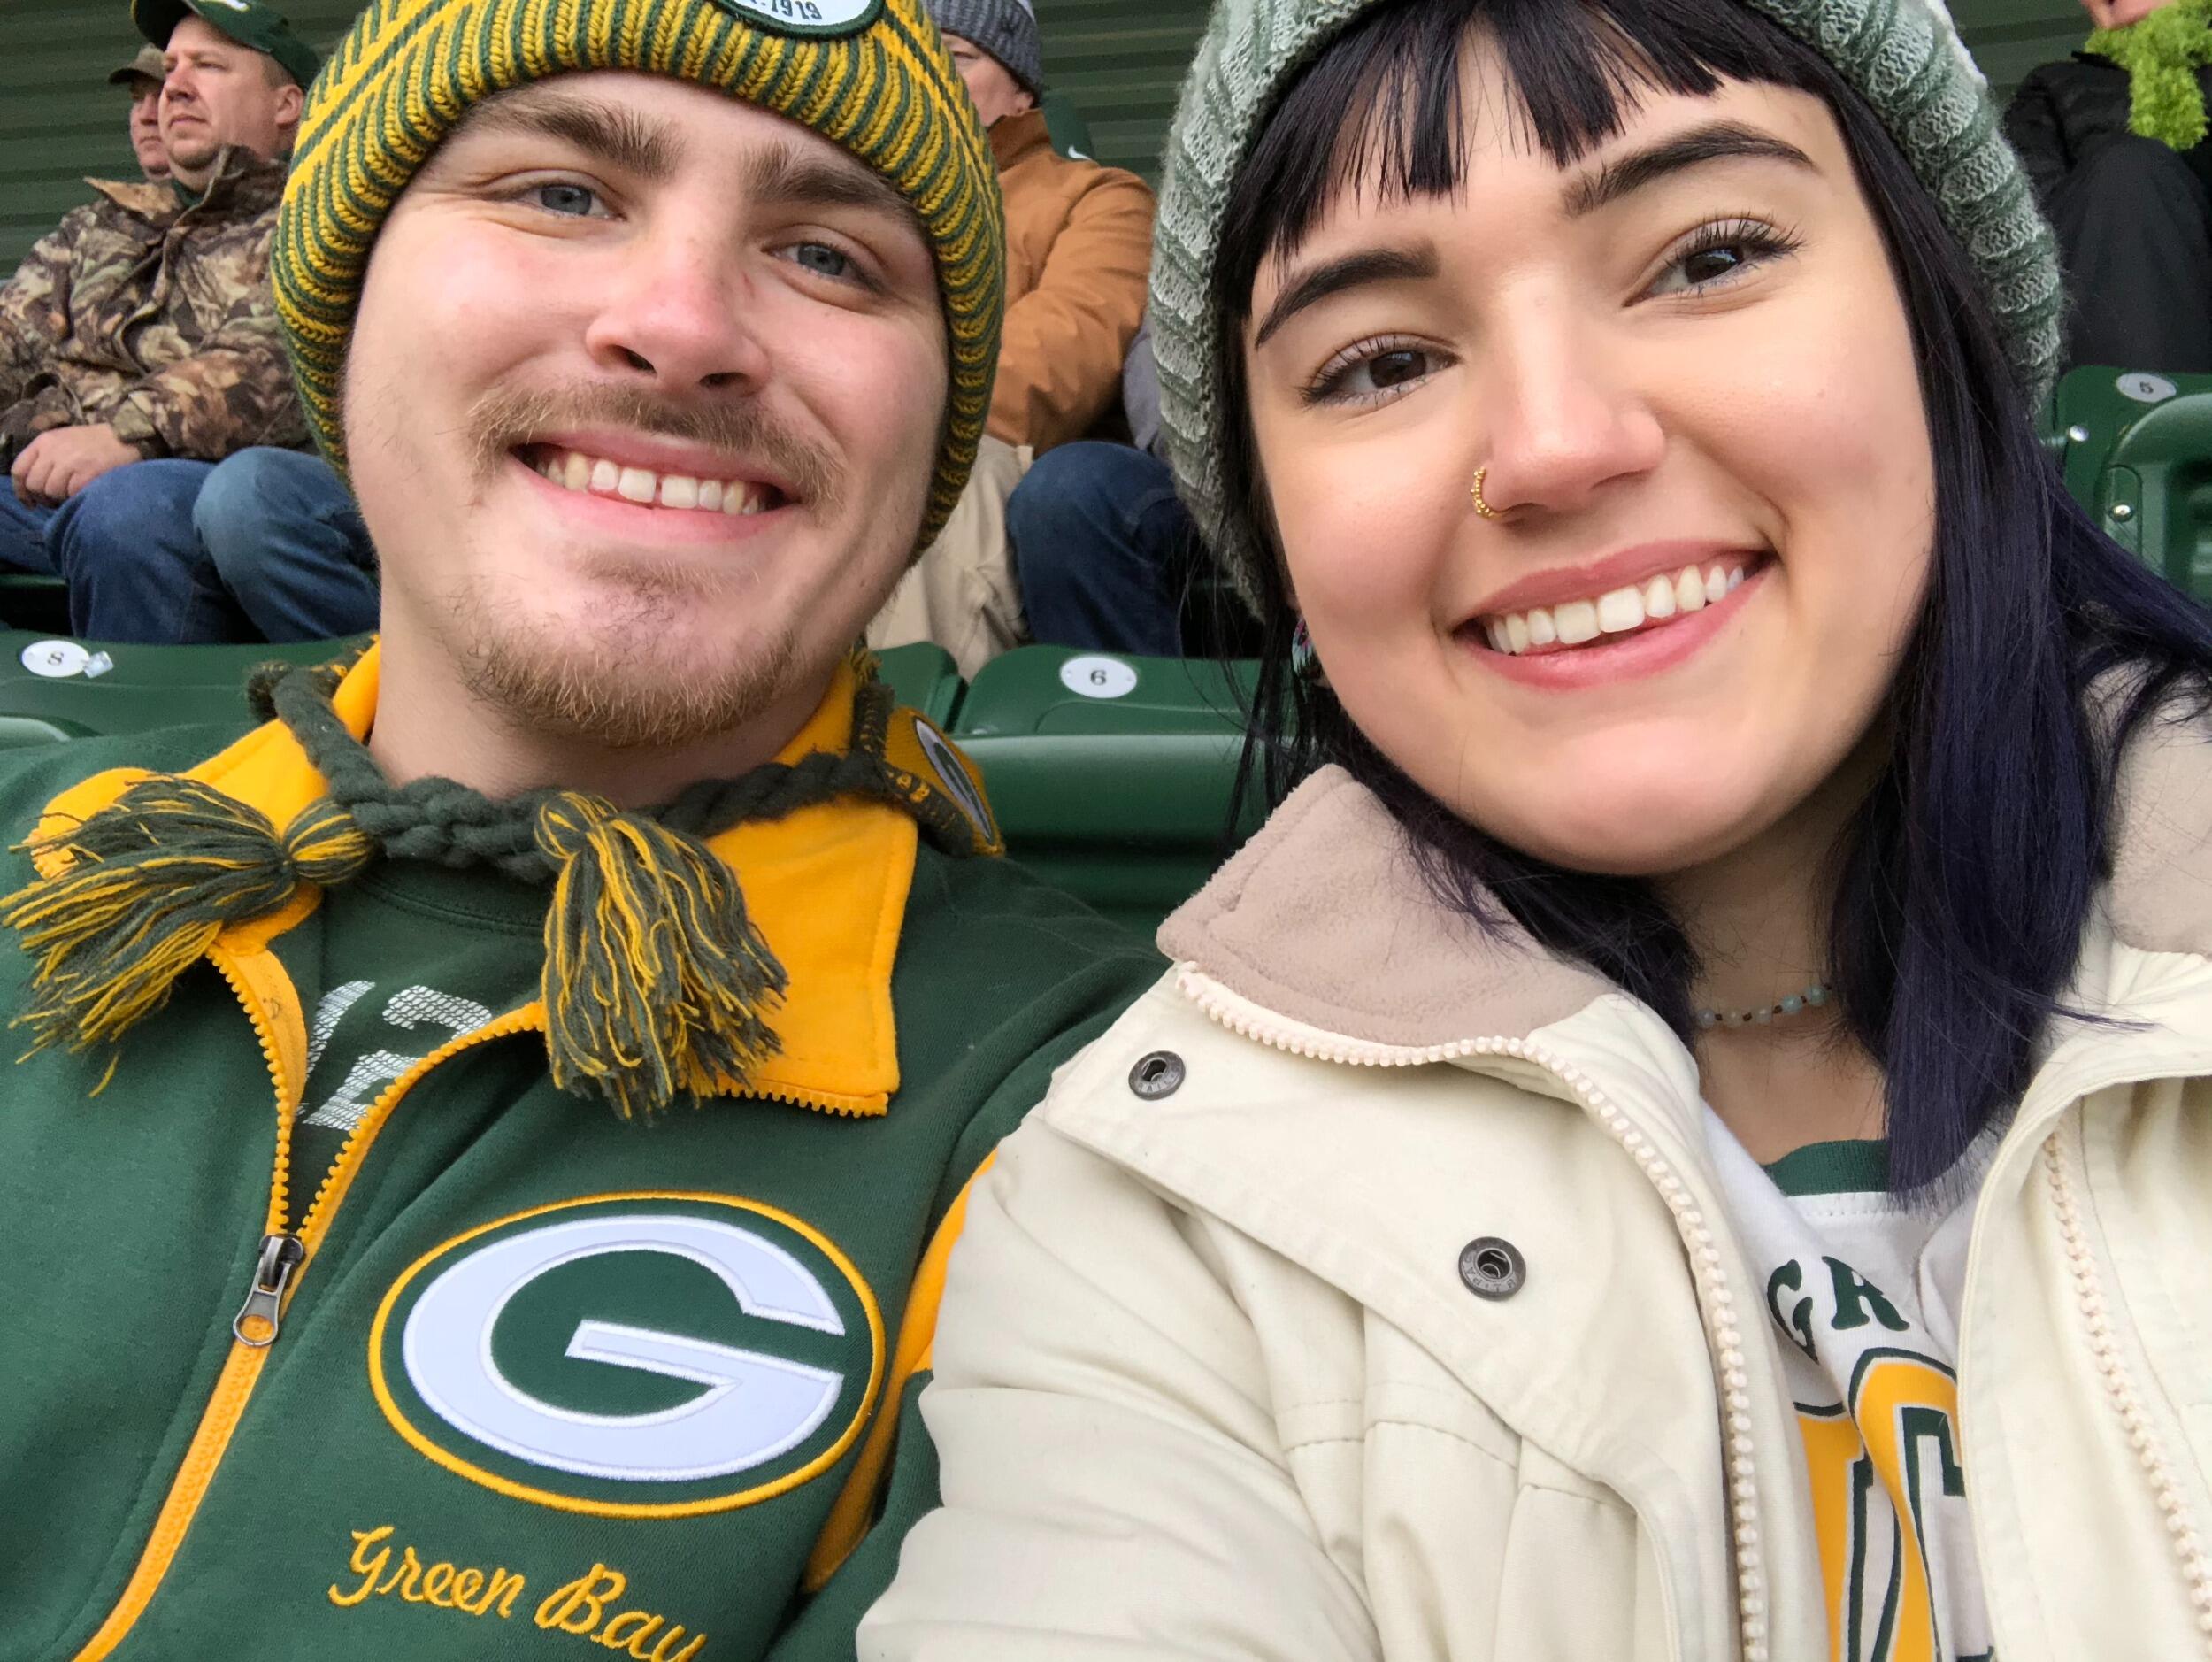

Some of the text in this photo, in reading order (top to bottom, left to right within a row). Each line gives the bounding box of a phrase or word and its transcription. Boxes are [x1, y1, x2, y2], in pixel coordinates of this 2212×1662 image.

[2139, 381, 2154, 395] 5
[47, 650, 65, 666] 8
[1090, 669, 1107, 686] 6
[403, 1214, 845, 1482] G
[328, 1525, 526, 1619] Green
